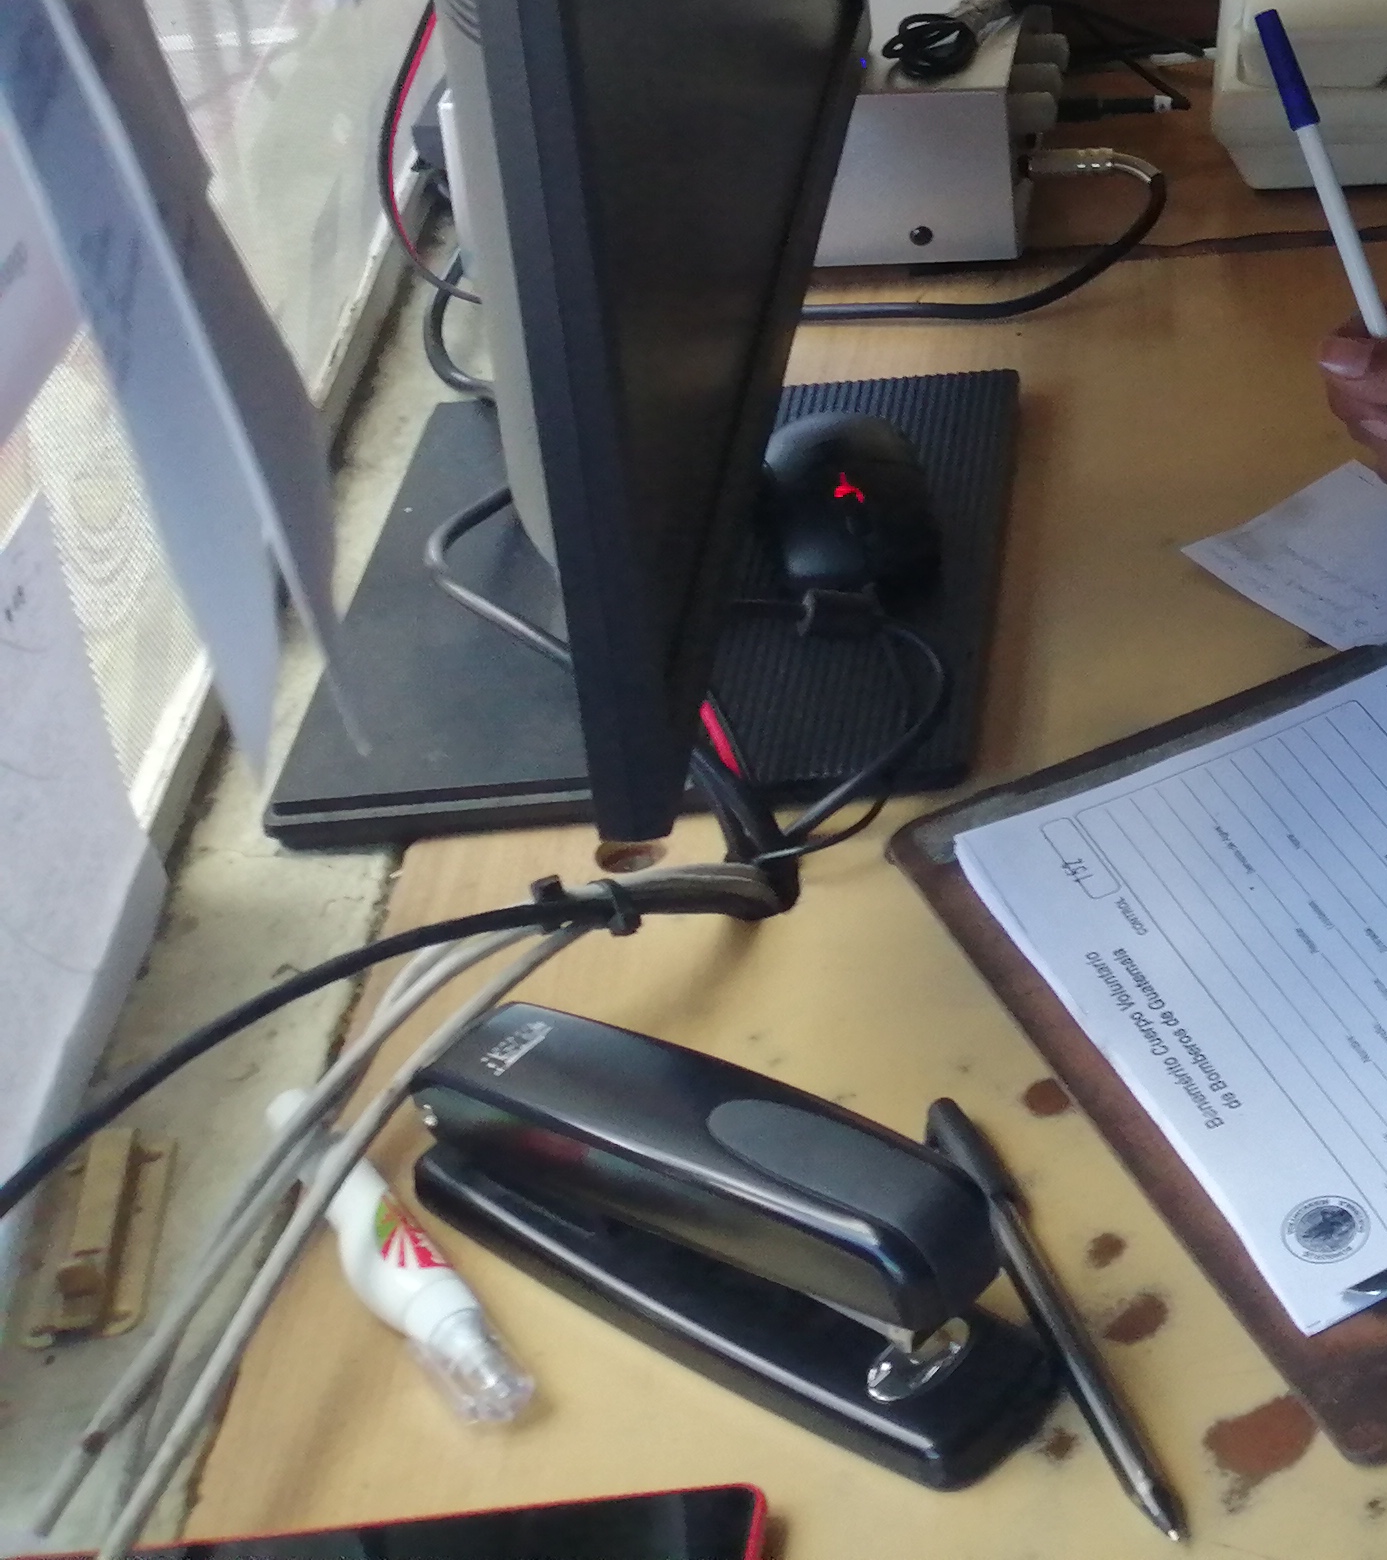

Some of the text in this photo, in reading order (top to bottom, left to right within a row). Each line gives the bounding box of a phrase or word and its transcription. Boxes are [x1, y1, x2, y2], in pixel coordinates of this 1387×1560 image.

[1115, 896, 1149, 936] CONTROL
[1084, 951, 1225, 1130] Benemérito Cuerpo Voluntario
[1112, 947, 1242, 1110] de Bomberos de Guatemala
